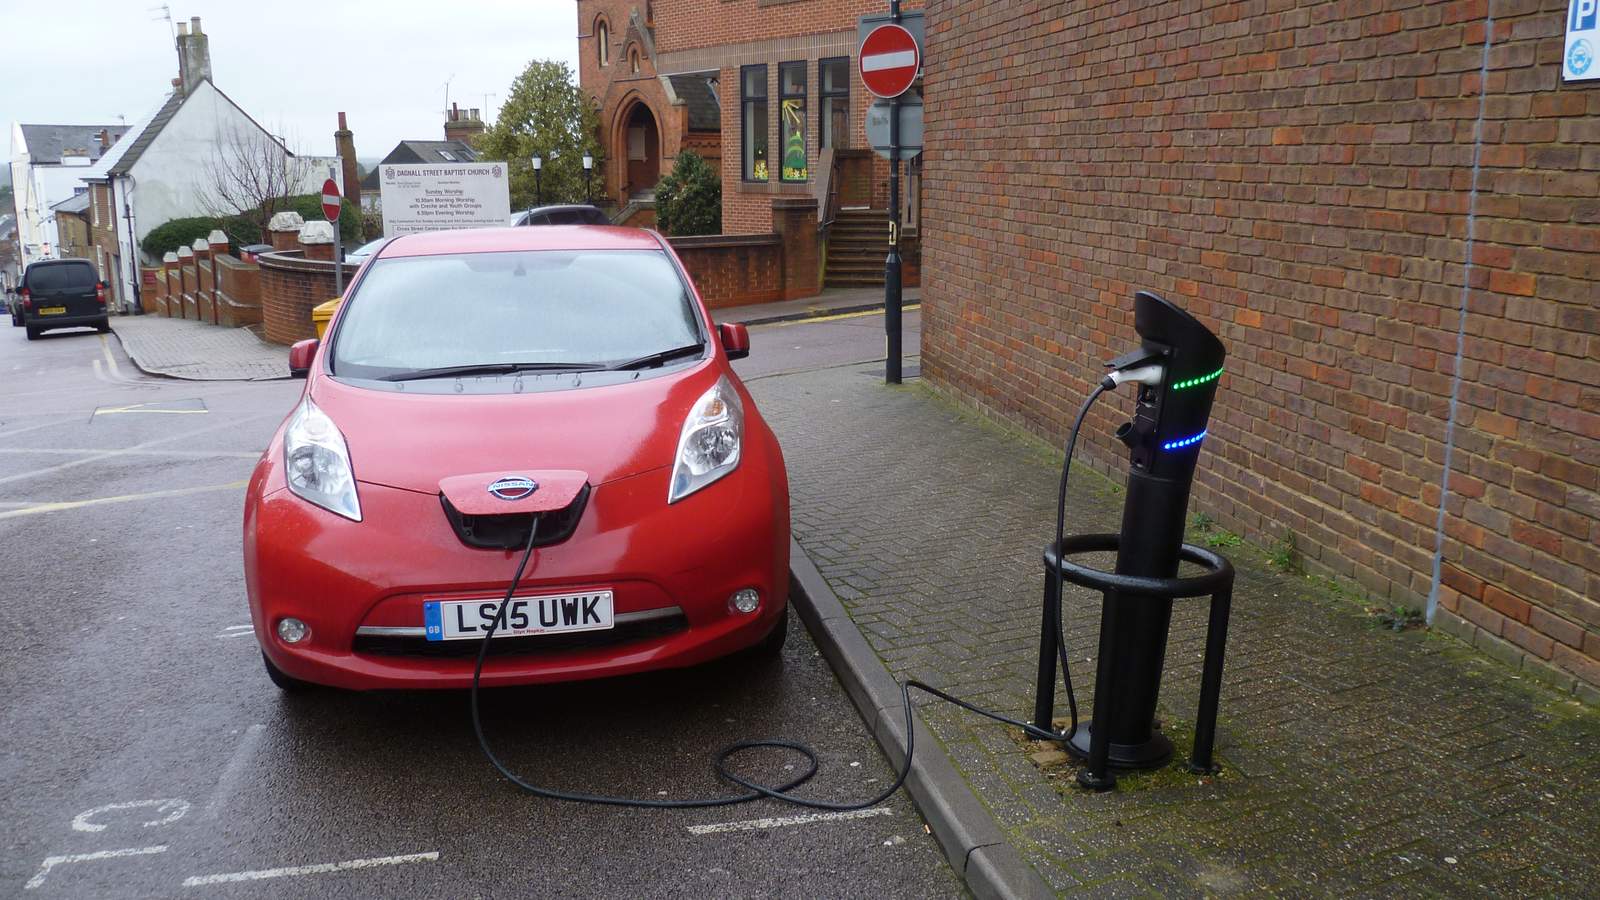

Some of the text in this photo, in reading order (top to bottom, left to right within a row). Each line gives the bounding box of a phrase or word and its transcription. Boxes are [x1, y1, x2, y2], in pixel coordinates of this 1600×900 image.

[1575, 0, 1596, 30] P
[396, 168, 490, 177] DAGNALL STREET BAPTIST CHURCH
[493, 480, 534, 490] NISSAN
[456, 595, 602, 633] LS15 UWK
[428, 625, 440, 634] GB
